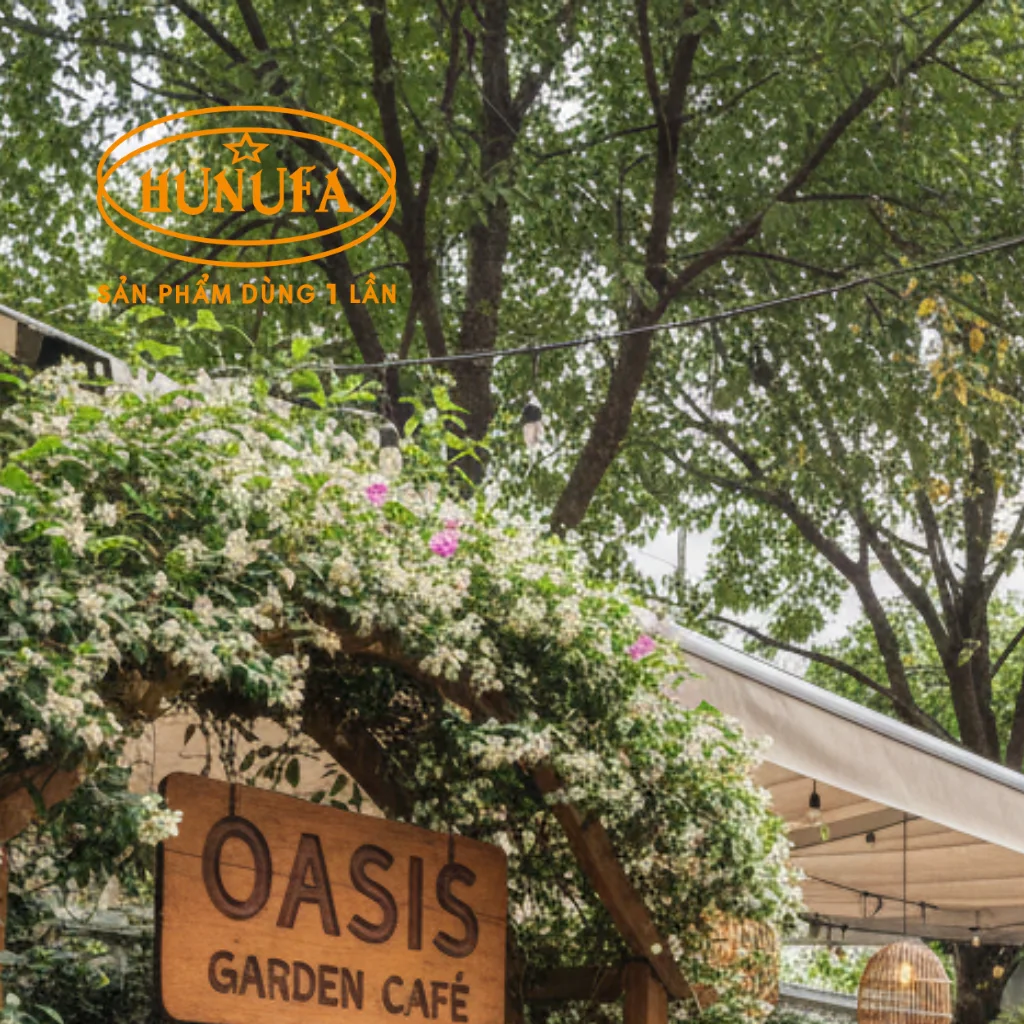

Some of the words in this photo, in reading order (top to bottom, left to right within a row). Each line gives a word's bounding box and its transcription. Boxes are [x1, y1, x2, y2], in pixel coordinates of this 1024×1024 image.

[202, 815, 479, 958] OASIS
[208, 950, 365, 1011] GARDEN
[381, 971, 471, 1023] CAFÉ
